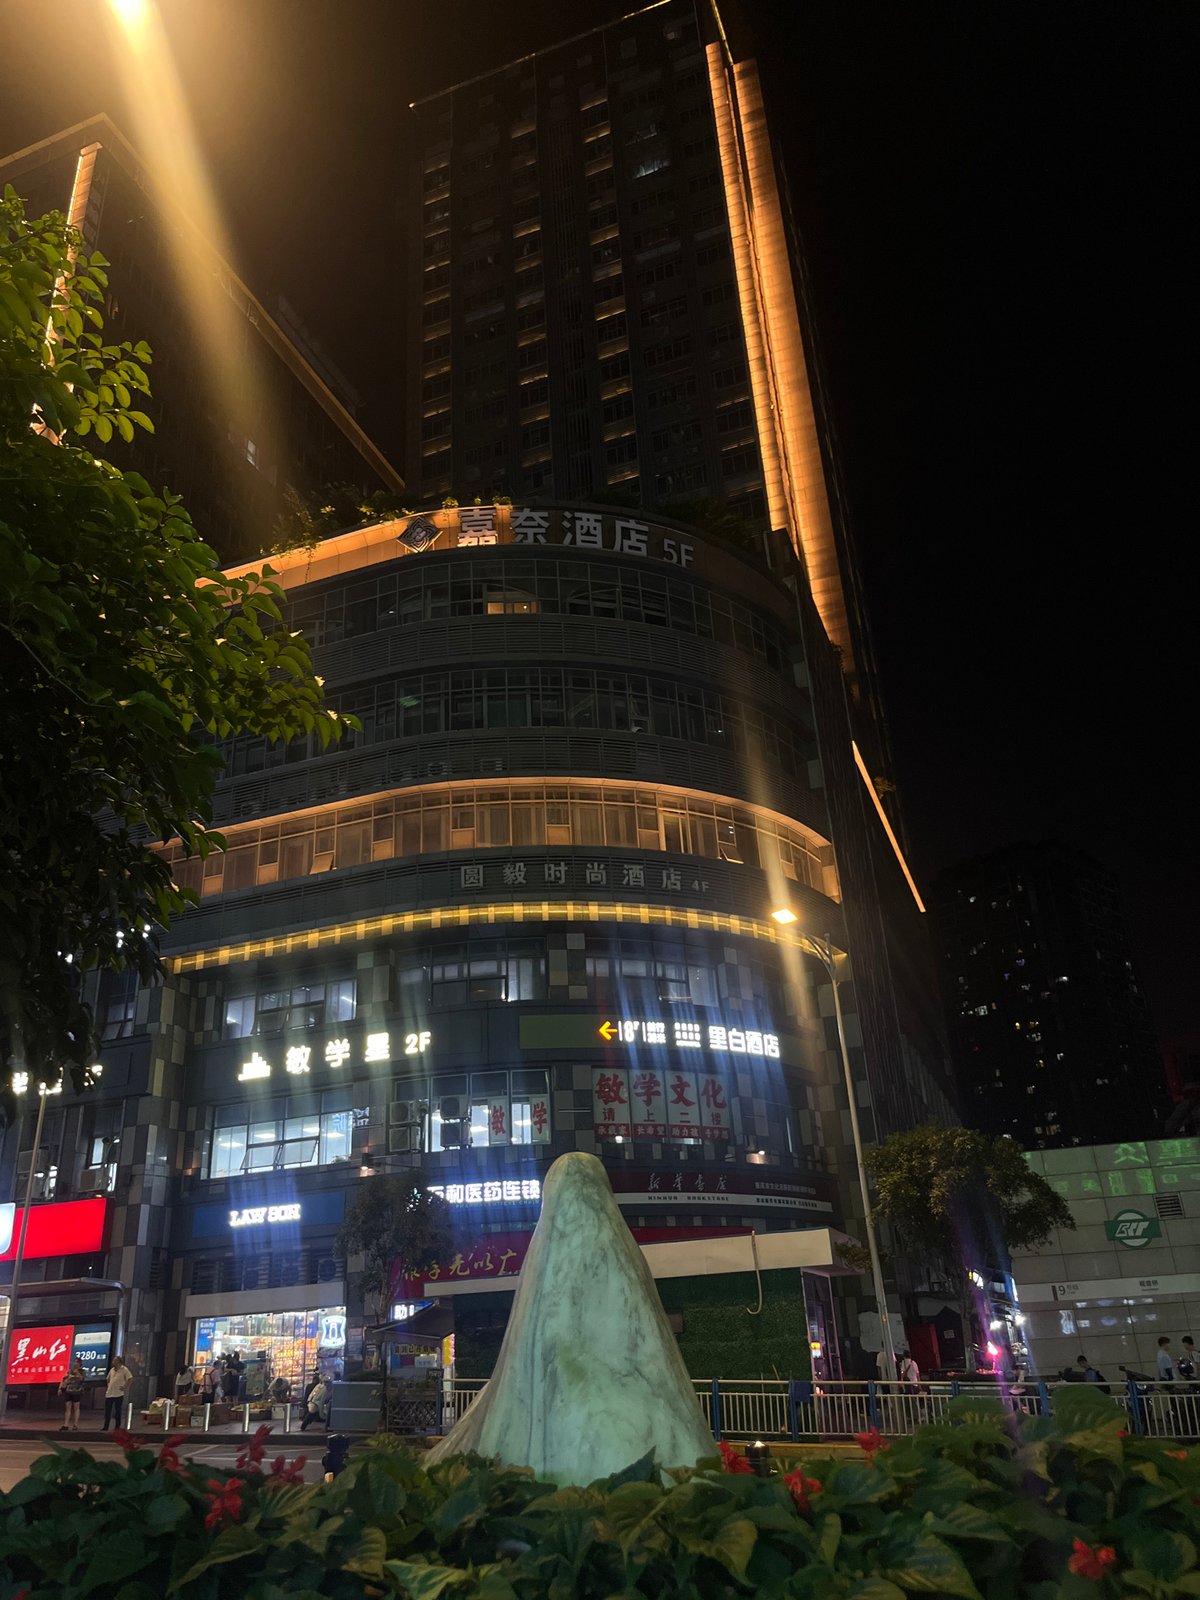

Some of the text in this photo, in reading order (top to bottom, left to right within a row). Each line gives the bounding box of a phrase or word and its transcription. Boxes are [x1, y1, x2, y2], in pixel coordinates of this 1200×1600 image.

[457, 507, 694, 568] 嘉奈酒店 5F
[460, 861, 710, 893] 圆毅时尚酒店 4F
[404, 1031, 432, 1055] 2F
[708, 1025, 780, 1058] 里白酒店
[595, 1072, 727, 1109] 敏学文化
[491, 1101, 548, 1136] 敏学
